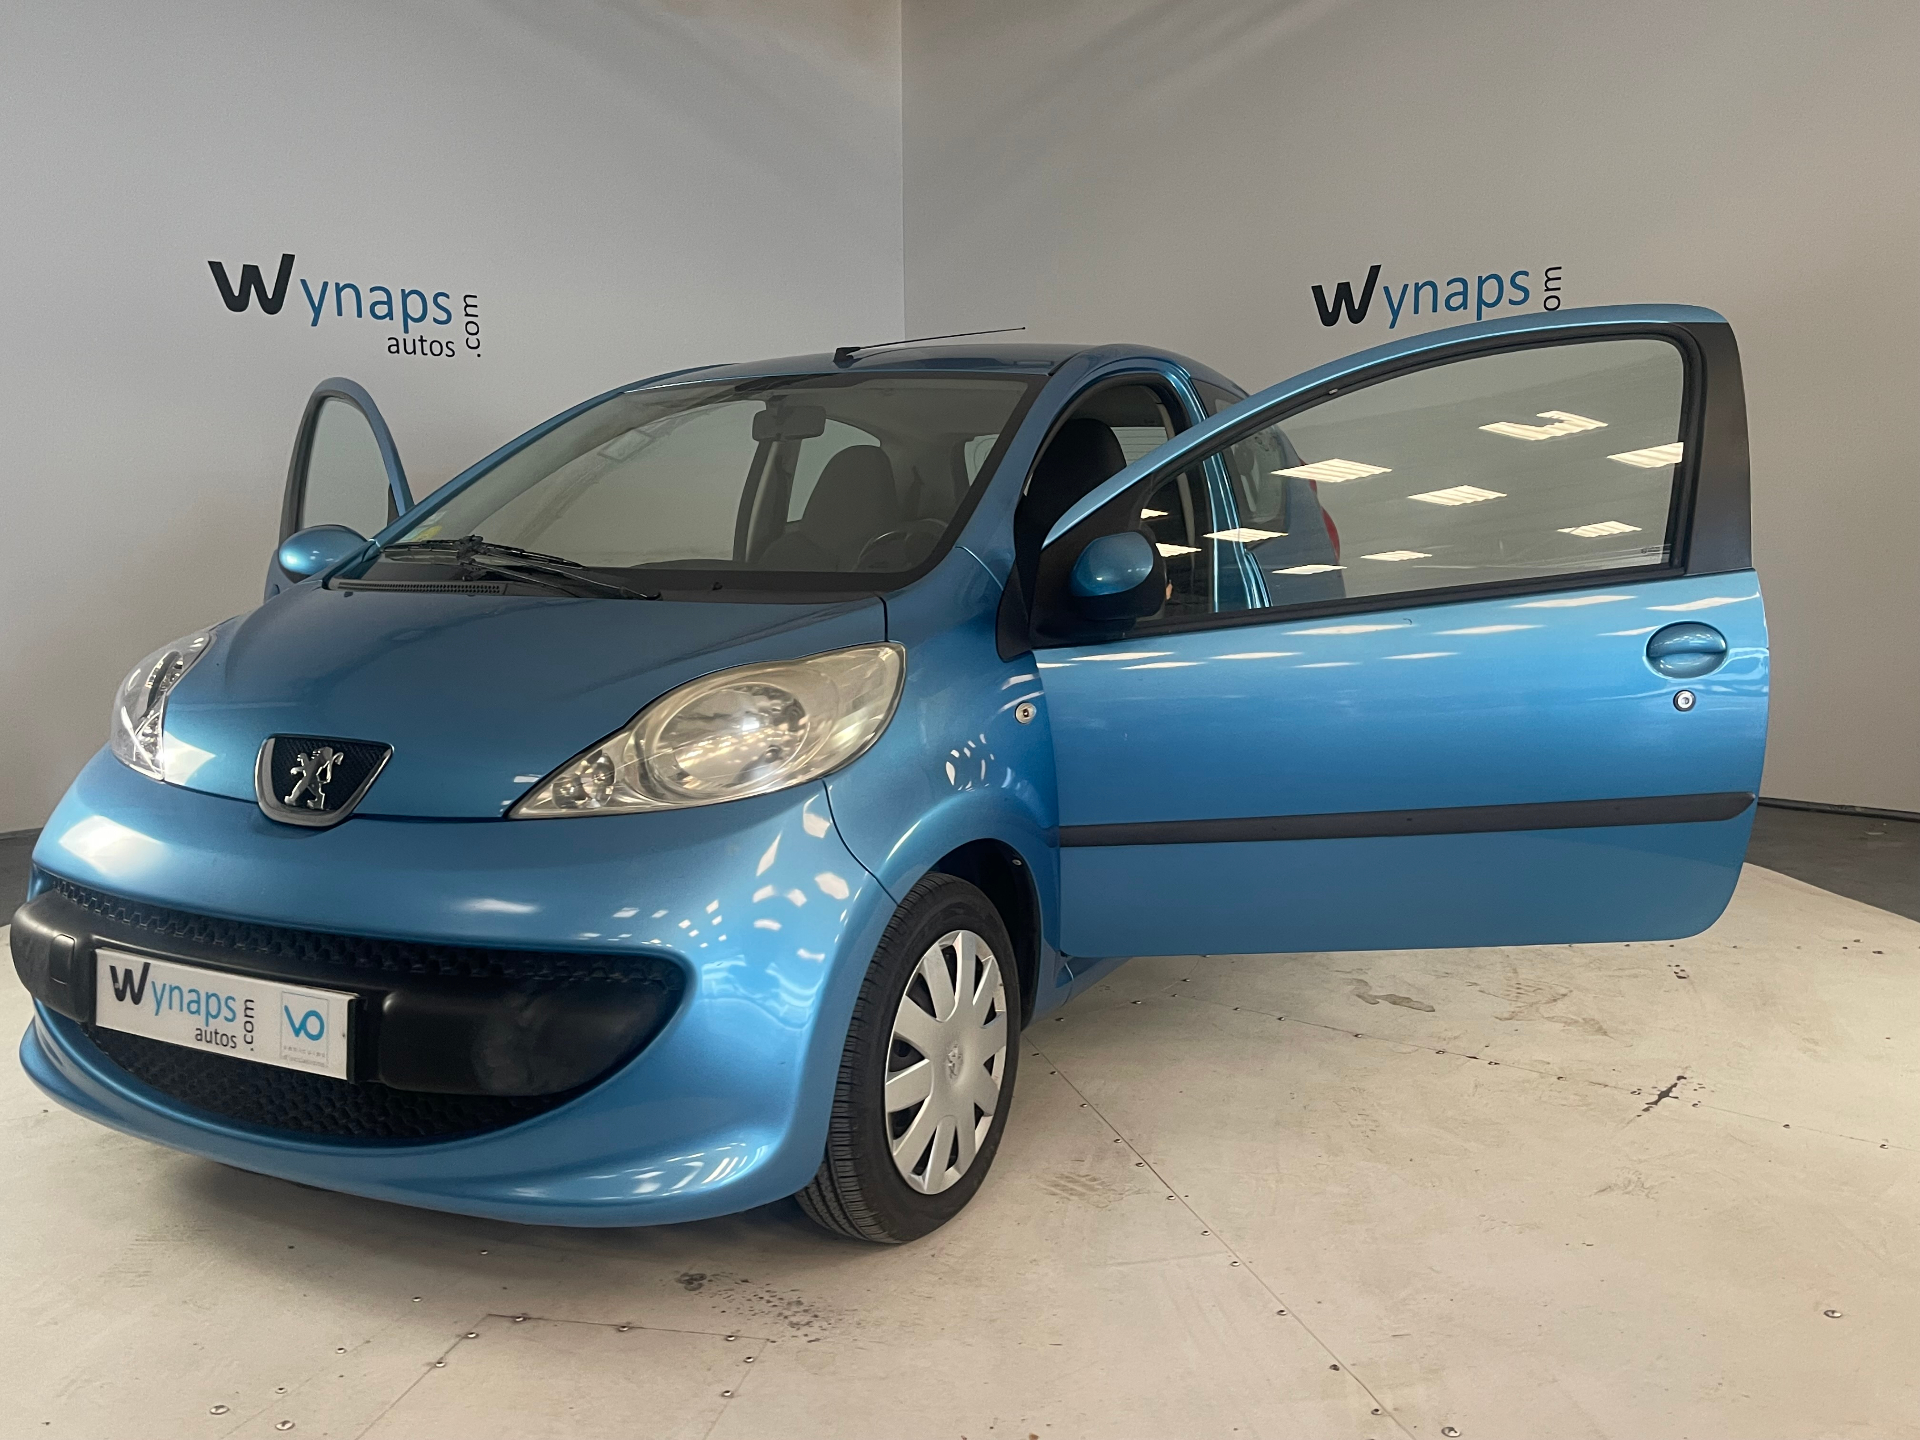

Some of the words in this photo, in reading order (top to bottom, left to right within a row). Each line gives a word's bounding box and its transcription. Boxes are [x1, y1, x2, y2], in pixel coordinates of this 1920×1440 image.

[207, 253, 453, 334] Wynaps
[1311, 264, 1531, 330] Wynaps
[1543, 266, 1563, 311] om
[387, 335, 456, 358] autos
[463, 294, 481, 358] .com
[109, 962, 237, 1027] Wynaps
[195, 1027, 237, 1049] autos
[243, 999, 255, 1051] .com
